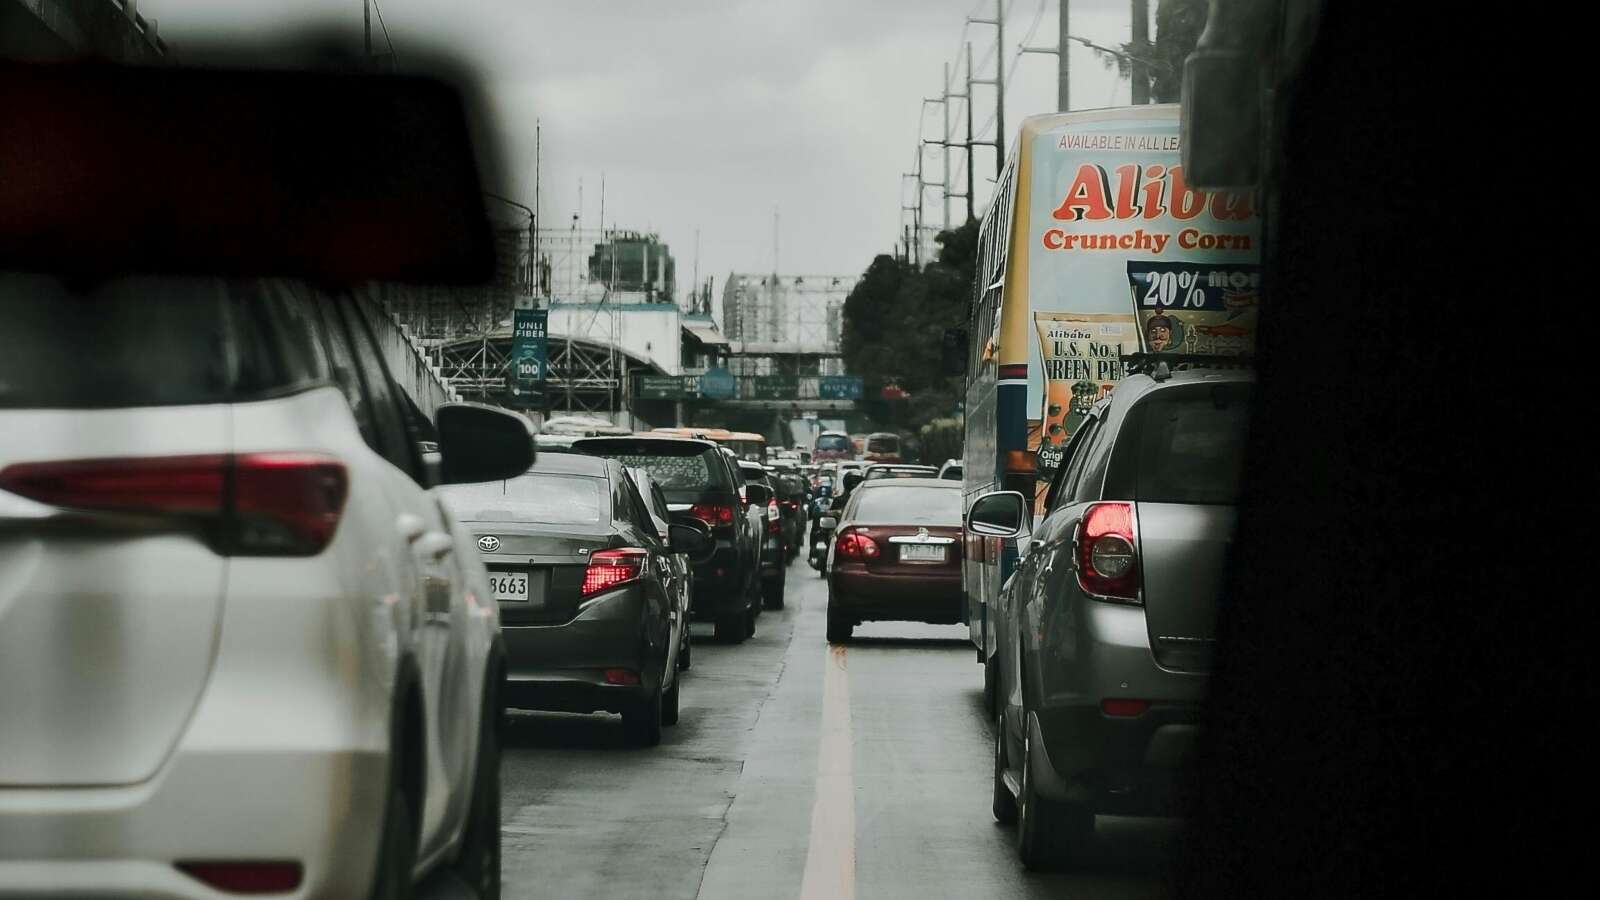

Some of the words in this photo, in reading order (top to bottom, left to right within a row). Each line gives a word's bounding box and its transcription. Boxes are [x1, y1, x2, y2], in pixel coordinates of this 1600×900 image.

[1058, 135, 1121, 150] AVAILABLE
[1125, 136, 1137, 150] IN
[1138, 136, 1160, 150] ALL
[1043, 228, 1170, 253] Crunchy
[1178, 228, 1251, 251] Corn
[1143, 270, 1206, 308] 20%
[519, 321, 543, 330] UNLI
[516, 330, 545, 338] FIBER
[1047, 329, 1091, 339] Alibaba
[1054, 341, 1082, 357] U.S.
[520, 363, 539, 375] 100
[1046, 360, 1091, 380] GREEN
[490, 577, 526, 594] 8663
